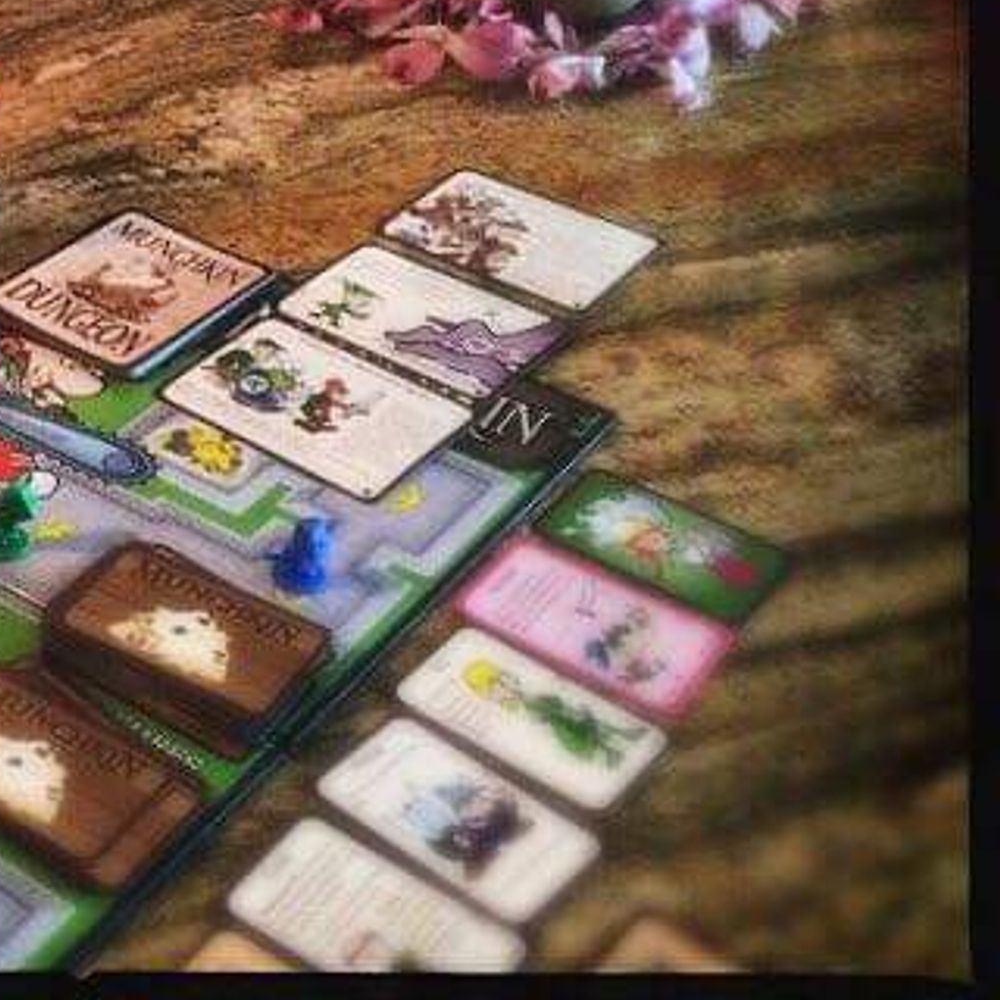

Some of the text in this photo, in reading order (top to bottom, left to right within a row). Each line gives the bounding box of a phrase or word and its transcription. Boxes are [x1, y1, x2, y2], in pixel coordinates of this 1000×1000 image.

[117, 219, 241, 286] MUNCHKIN
[4, 278, 136, 352] DUNGEON
[137, 555, 306, 650] MUNCHKIN
